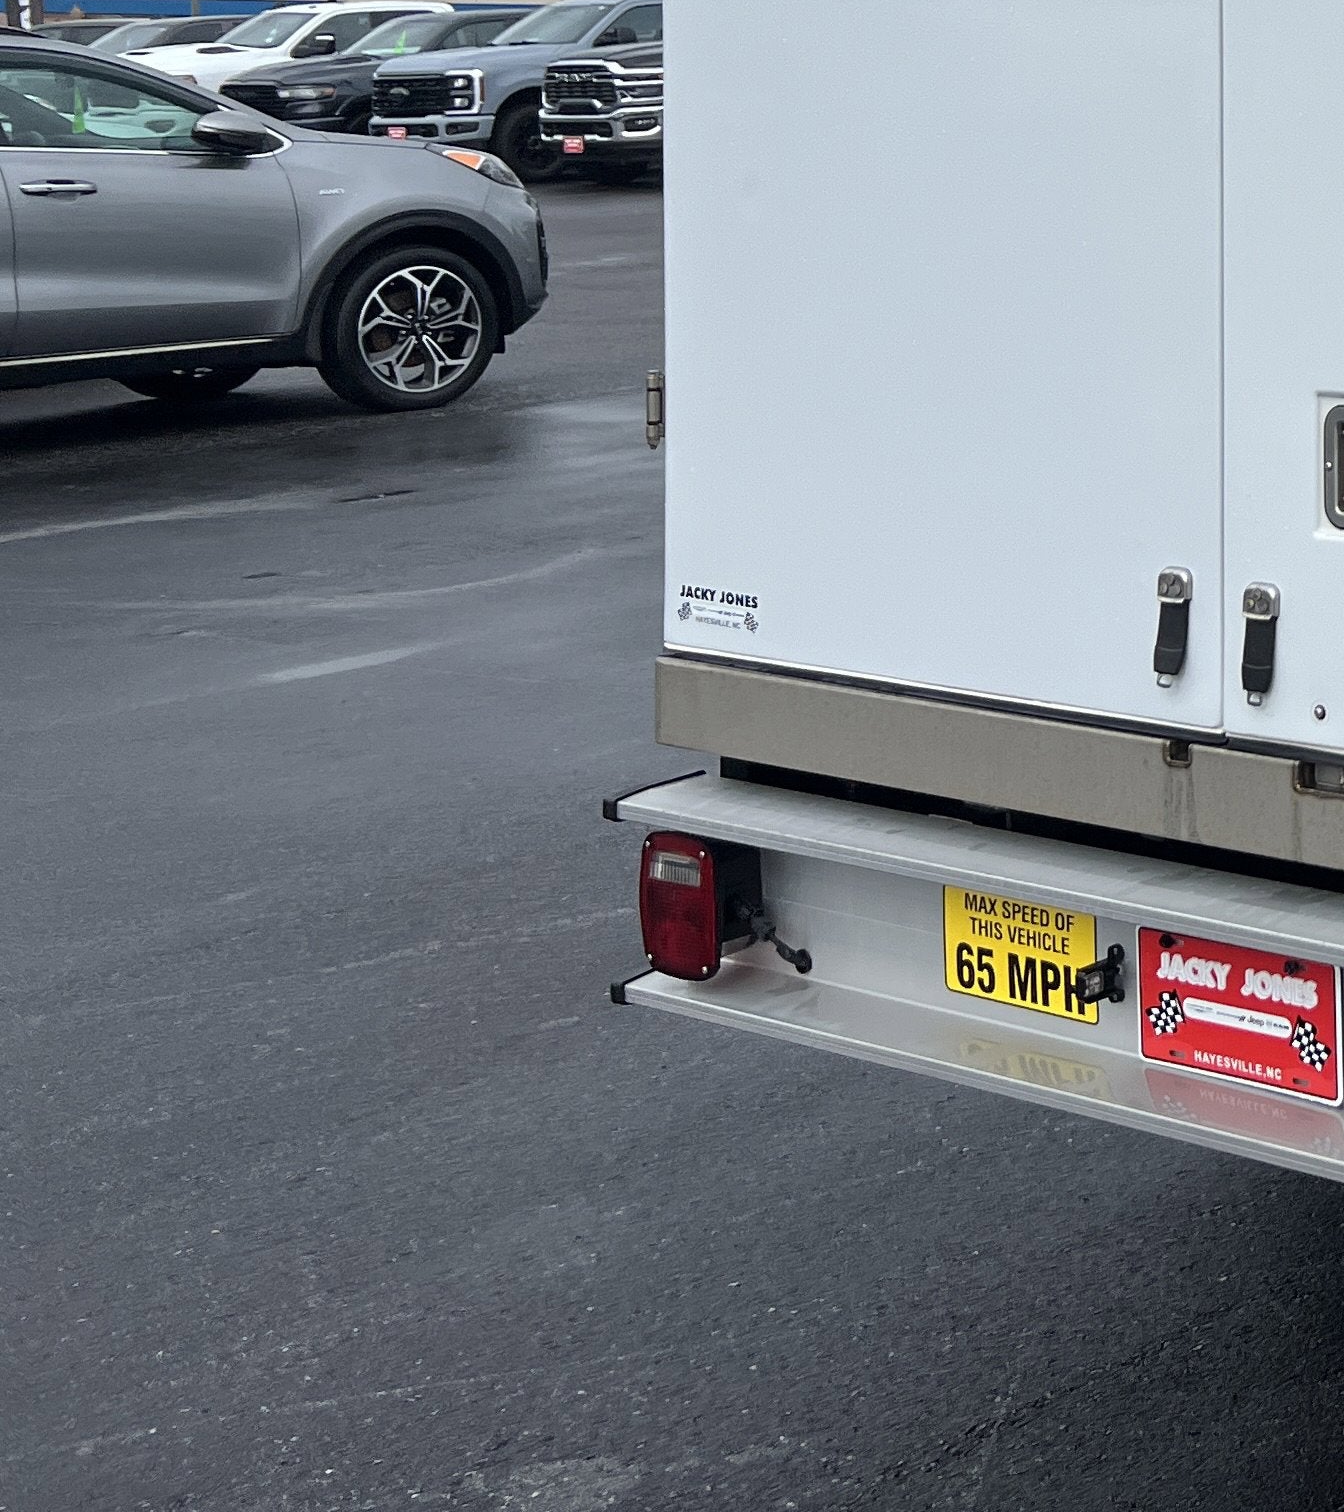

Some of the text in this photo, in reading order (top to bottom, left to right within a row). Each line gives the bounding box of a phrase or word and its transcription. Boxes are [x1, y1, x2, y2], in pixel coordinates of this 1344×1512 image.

[680, 584, 759, 609] JACKY JONES
[964, 892, 1075, 932] MAX SPEED OF
[969, 916, 1070, 955] THIS VEHICLE
[956, 941, 1086, 1016] 65 MPH
[1156, 951, 1319, 1009] JACKY JONES
[1247, 1015, 1265, 1028] Jeep
